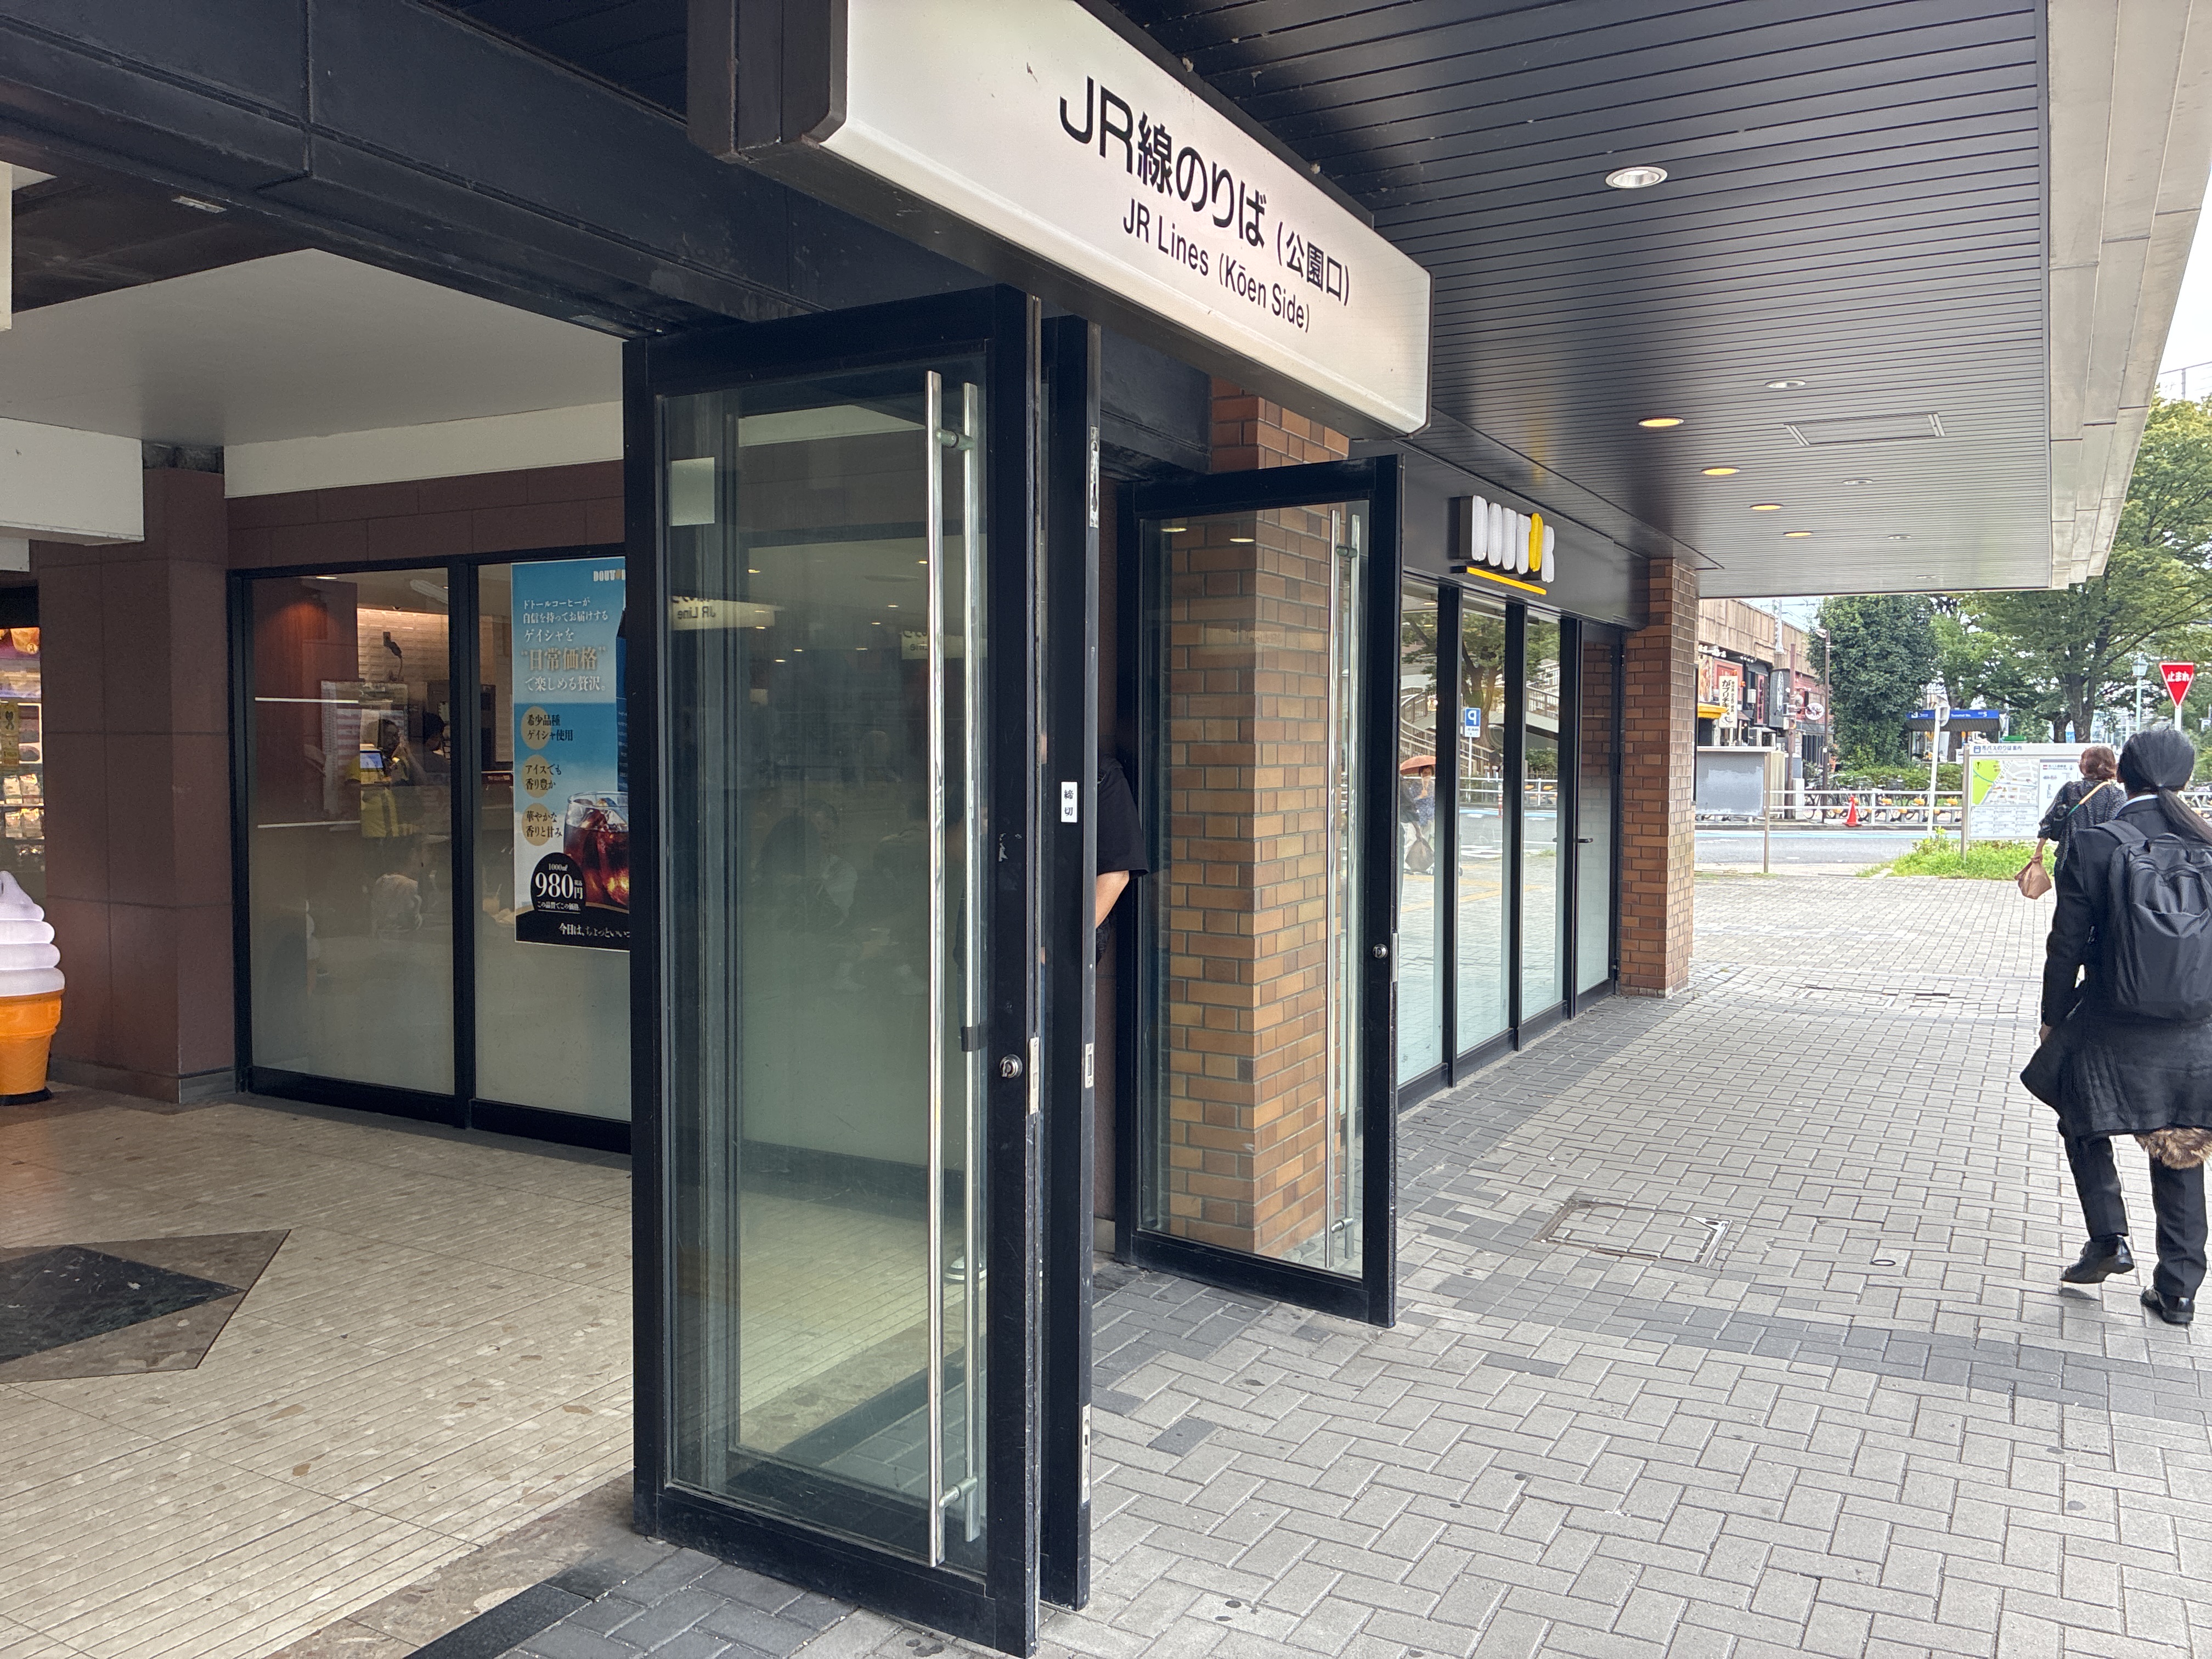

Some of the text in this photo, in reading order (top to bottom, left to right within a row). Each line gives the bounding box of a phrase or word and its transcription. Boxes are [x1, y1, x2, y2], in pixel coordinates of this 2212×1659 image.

[1123, 199, 1310, 334] JR Lines (Kōen Side)
[523, 598, 591, 610] ドトールコーヒーが
[523, 611, 608, 624] 自信を持ってお届けする
[524, 628, 575, 642] ゲイシャを
[2167, 670, 2190, 682] 止まれ
[524, 675, 606, 692] で楽しめる贅沢。
[526, 714, 561, 727] 希少品種
[526, 729, 573, 741] ゲイシャ使用
[525, 763, 562, 776] アイスでも
[525, 778, 556, 791] 香り豊か
[1064, 789, 1074, 816] 締切
[526, 810, 558, 823] 華やかな
[525, 825, 563, 838] 香りと甘み
